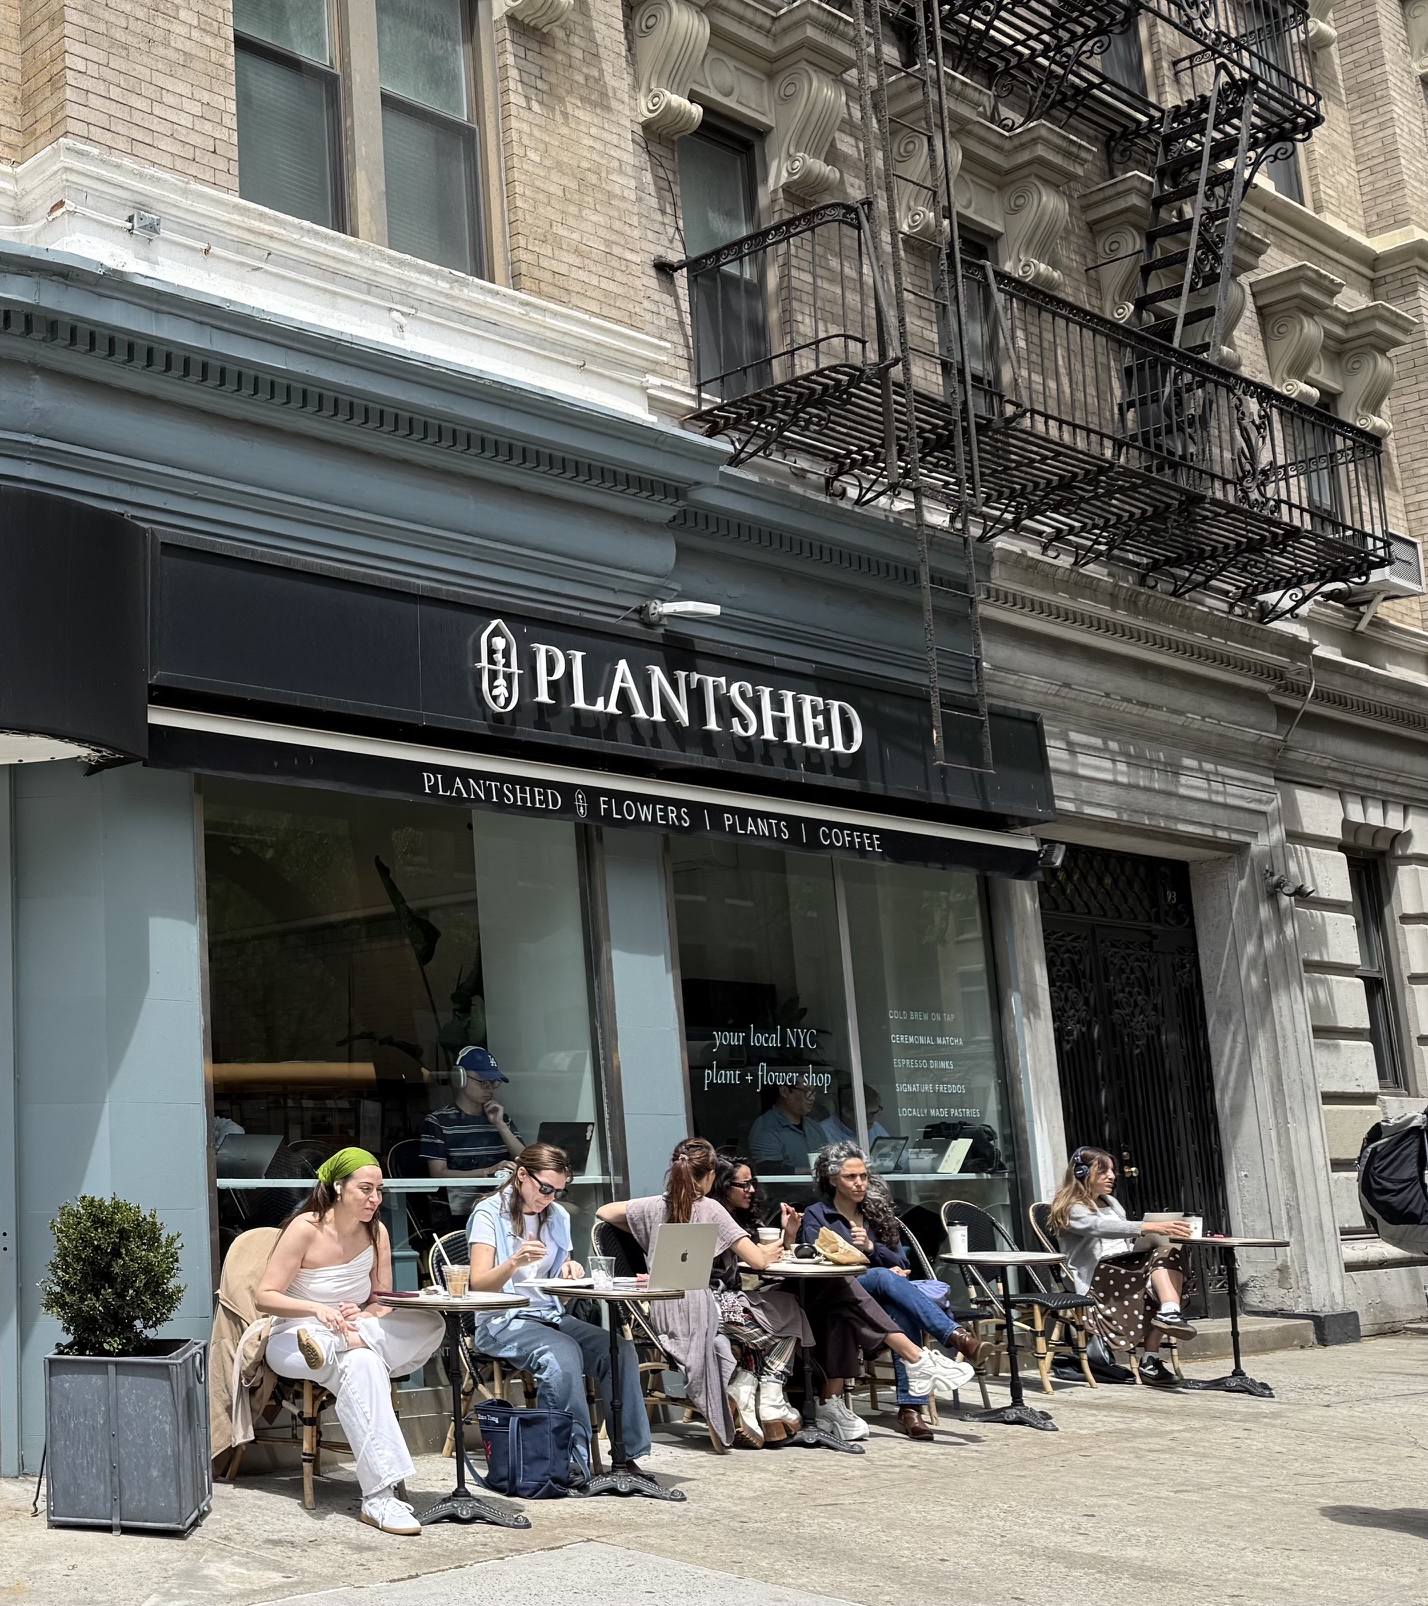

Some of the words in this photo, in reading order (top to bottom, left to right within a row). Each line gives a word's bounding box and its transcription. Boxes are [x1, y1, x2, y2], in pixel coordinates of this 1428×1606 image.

[530, 642, 863, 754] PLANTSHED
[421, 772, 562, 811] PLANTSHED
[599, 796, 690, 827] FLOWERS
[723, 813, 789, 839] PLANTS
[819, 826, 883, 852] COFFEE
[888, 1010, 908, 1019] COLD
[910, 1011, 929, 1021] BREW
[931, 1012, 942, 1021] ON
[943, 1013, 955, 1022] TAP
[712, 1030, 746, 1052] your
[750, 1024, 781, 1047] local
[786, 1028, 817, 1049] NYC
[890, 1034, 935, 1045] CEREMONIAL
[936, 1036, 964, 1046] MATCHA
[893, 1058, 928, 1068] ESPRESSO
[929, 1060, 954, 1070] DRINKS
[704, 1060, 741, 1091] plant
[756, 1062, 799, 1092] flower
[803, 1064, 832, 1094] shop
[895, 1083, 934, 1093] SIGNATURE
[935, 1084, 966, 1094] FREDDOS
[898, 1107, 928, 1117] LOCALLY
[930, 1108, 949, 1117] MADE
[950, 1108, 981, 1118] PASTRIES
